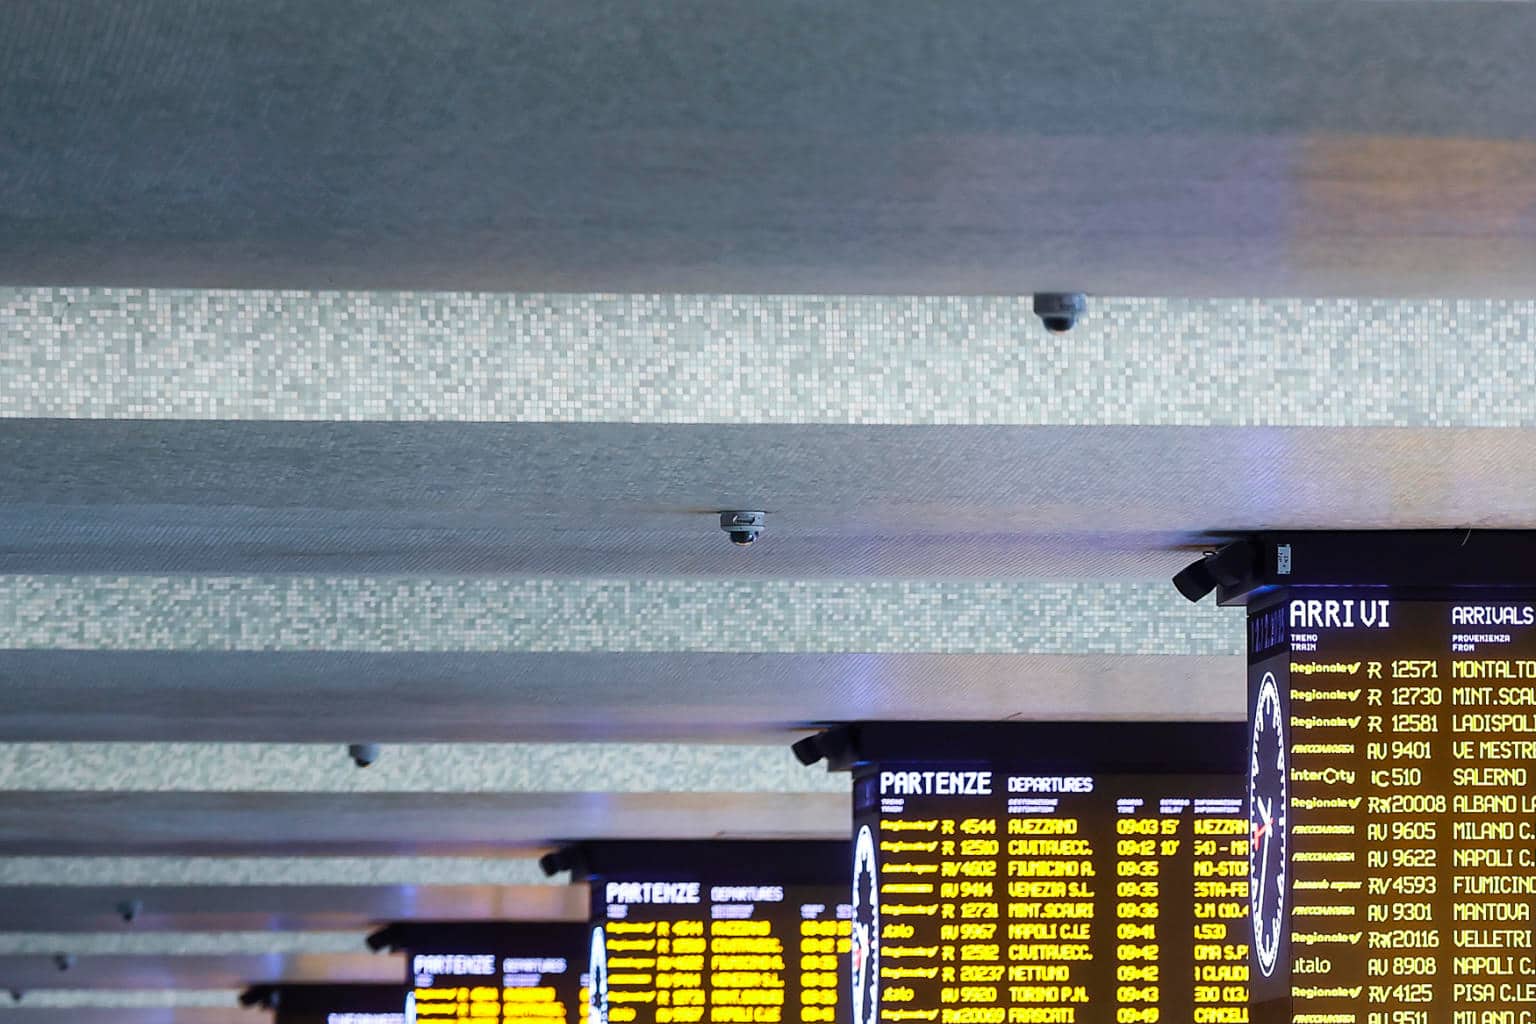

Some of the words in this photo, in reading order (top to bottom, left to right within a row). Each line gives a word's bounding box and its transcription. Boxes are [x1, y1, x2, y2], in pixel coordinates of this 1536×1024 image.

[1289, 599, 1390, 628] ARRIVI
[1451, 606, 1534, 625] ARRIVALS
[1290, 633, 1318, 643] TRENO
[1290, 642, 1317, 652] TRAIN
[1452, 642, 1475, 652] FROM
[1366, 661, 1383, 679] R
[1391, 660, 1439, 679] 12571
[1366, 688, 1383, 706] R
[1391, 686, 1442, 706] 12730
[1367, 715, 1383, 733] R
[1391, 713, 1439, 733] 12581
[1366, 742, 1388, 761] AV
[1391, 740, 1432, 760] 9401
[1452, 741, 1475, 760] VE
[879, 771, 993, 795] PARTENZE
[1007, 776, 1094, 793] DEPARTURES
[1391, 767, 1422, 786] 510
[1452, 767, 1527, 787] SALERNO
[1390, 794, 1447, 813] 20008
[1452, 794, 1517, 813] ALBANO
[1367, 823, 1388, 842] AV
[1391, 821, 1437, 841] 9605
[1453, 821, 1514, 840] MILANO
[1367, 850, 1389, 868] AV
[1392, 847, 1437, 868] 9622
[1453, 848, 1514, 867] NAPOLI
[605, 881, 701, 904] PARTENZE
[1367, 877, 1392, 895] RV
[1390, 875, 1437, 895] 4593
[1367, 904, 1389, 923] AV
[1392, 902, 1433, 921] 9301
[1453, 902, 1530, 921] MANTOVA
[1390, 927, 1440, 951] 20116
[1453, 929, 1533, 948] VELLETRI
[1367, 958, 1389, 977] AV
[1392, 953, 1437, 977] 8908
[1453, 956, 1514, 975] NAPOLI
[1367, 985, 1392, 1004] RV
[1390, 983, 1433, 1003] 4125
[1453, 983, 1496, 1002] PISA
[1499, 983, 1536, 1002] C.LE
